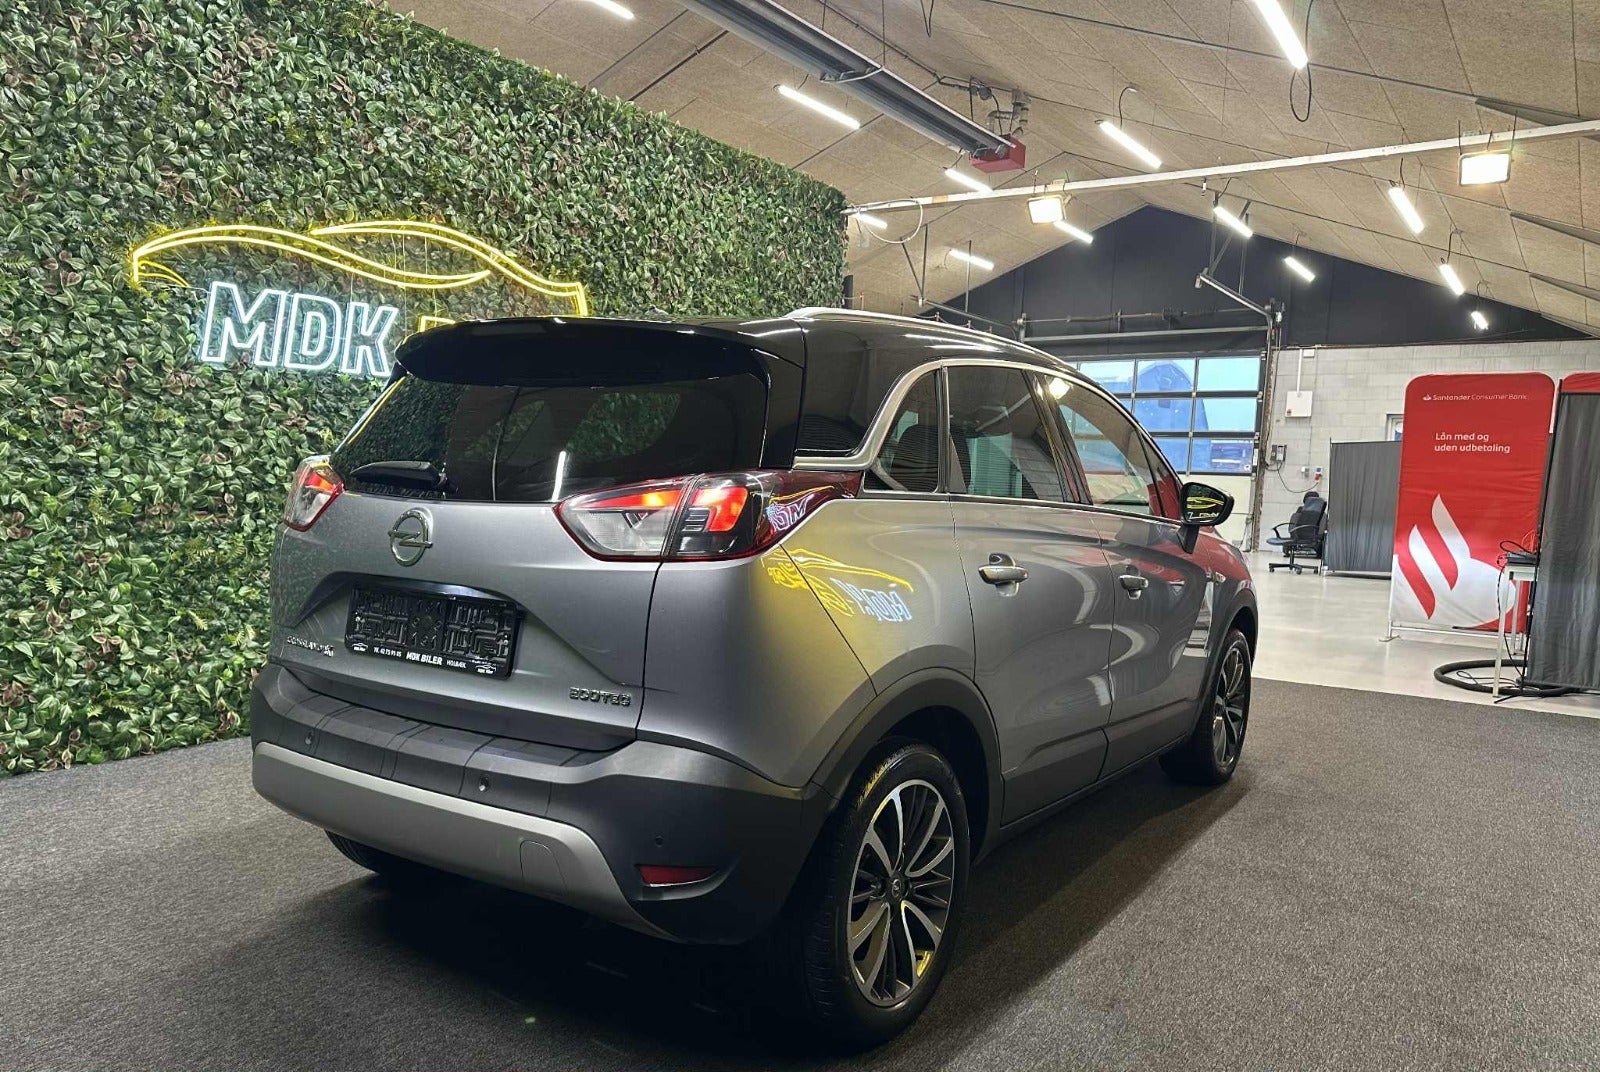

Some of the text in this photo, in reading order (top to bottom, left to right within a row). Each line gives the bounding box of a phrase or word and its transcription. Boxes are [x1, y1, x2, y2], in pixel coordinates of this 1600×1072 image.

[200, 280, 399, 377] MDK
[1435, 432, 1489, 442] Lån med og
[1434, 443, 1511, 454] uden udbetaling
[406, 651, 421, 662] MDK
[420, 653, 443, 666] BILER
